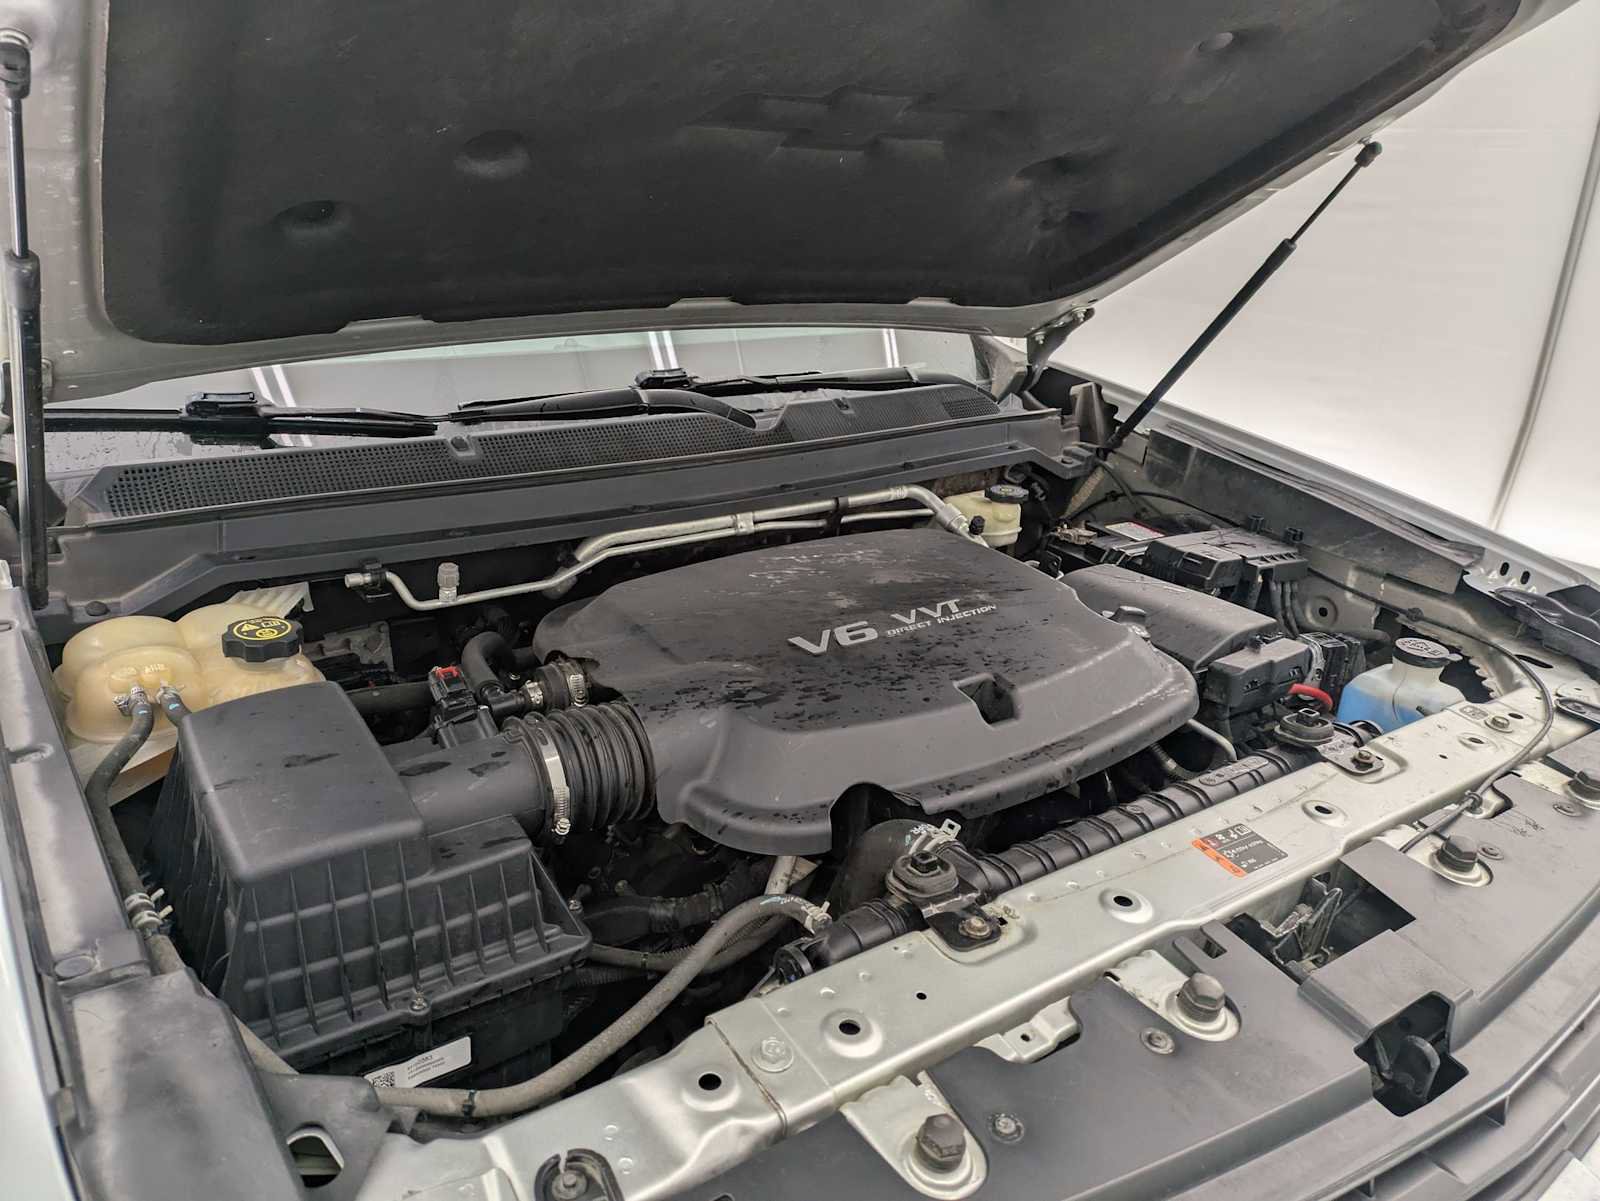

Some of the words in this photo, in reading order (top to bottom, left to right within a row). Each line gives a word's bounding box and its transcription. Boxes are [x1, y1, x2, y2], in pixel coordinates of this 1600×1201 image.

[787, 620, 879, 655] V6
[890, 598, 961, 625] VVT
[885, 619, 932, 638] DIRECT
[936, 603, 998, 625] INJECTION
